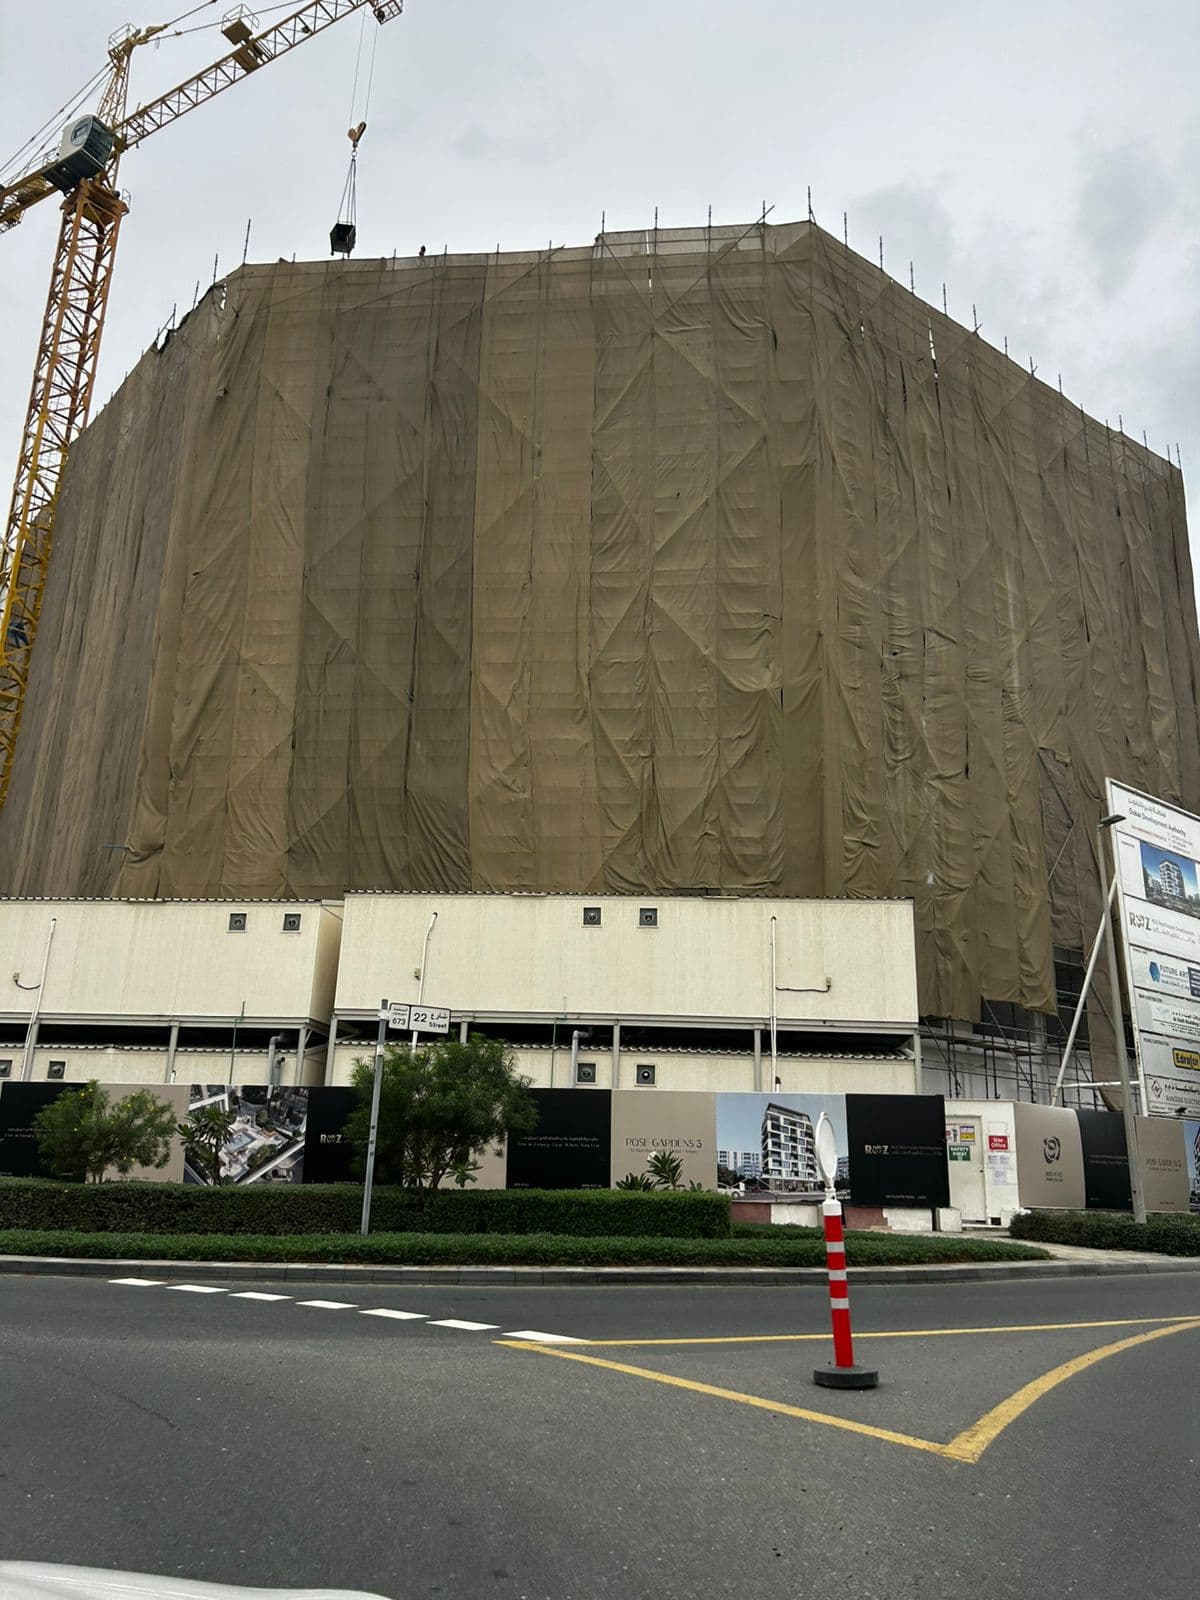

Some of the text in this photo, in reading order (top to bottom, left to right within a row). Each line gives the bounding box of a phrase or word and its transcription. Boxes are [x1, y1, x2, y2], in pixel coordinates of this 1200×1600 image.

[413, 1012, 427, 1023] 22
[430, 1012, 448, 1020] شارع
[392, 1017, 406, 1026] 673
[429, 1021, 447, 1029] Street
[696, 1139, 703, 1148] 3
